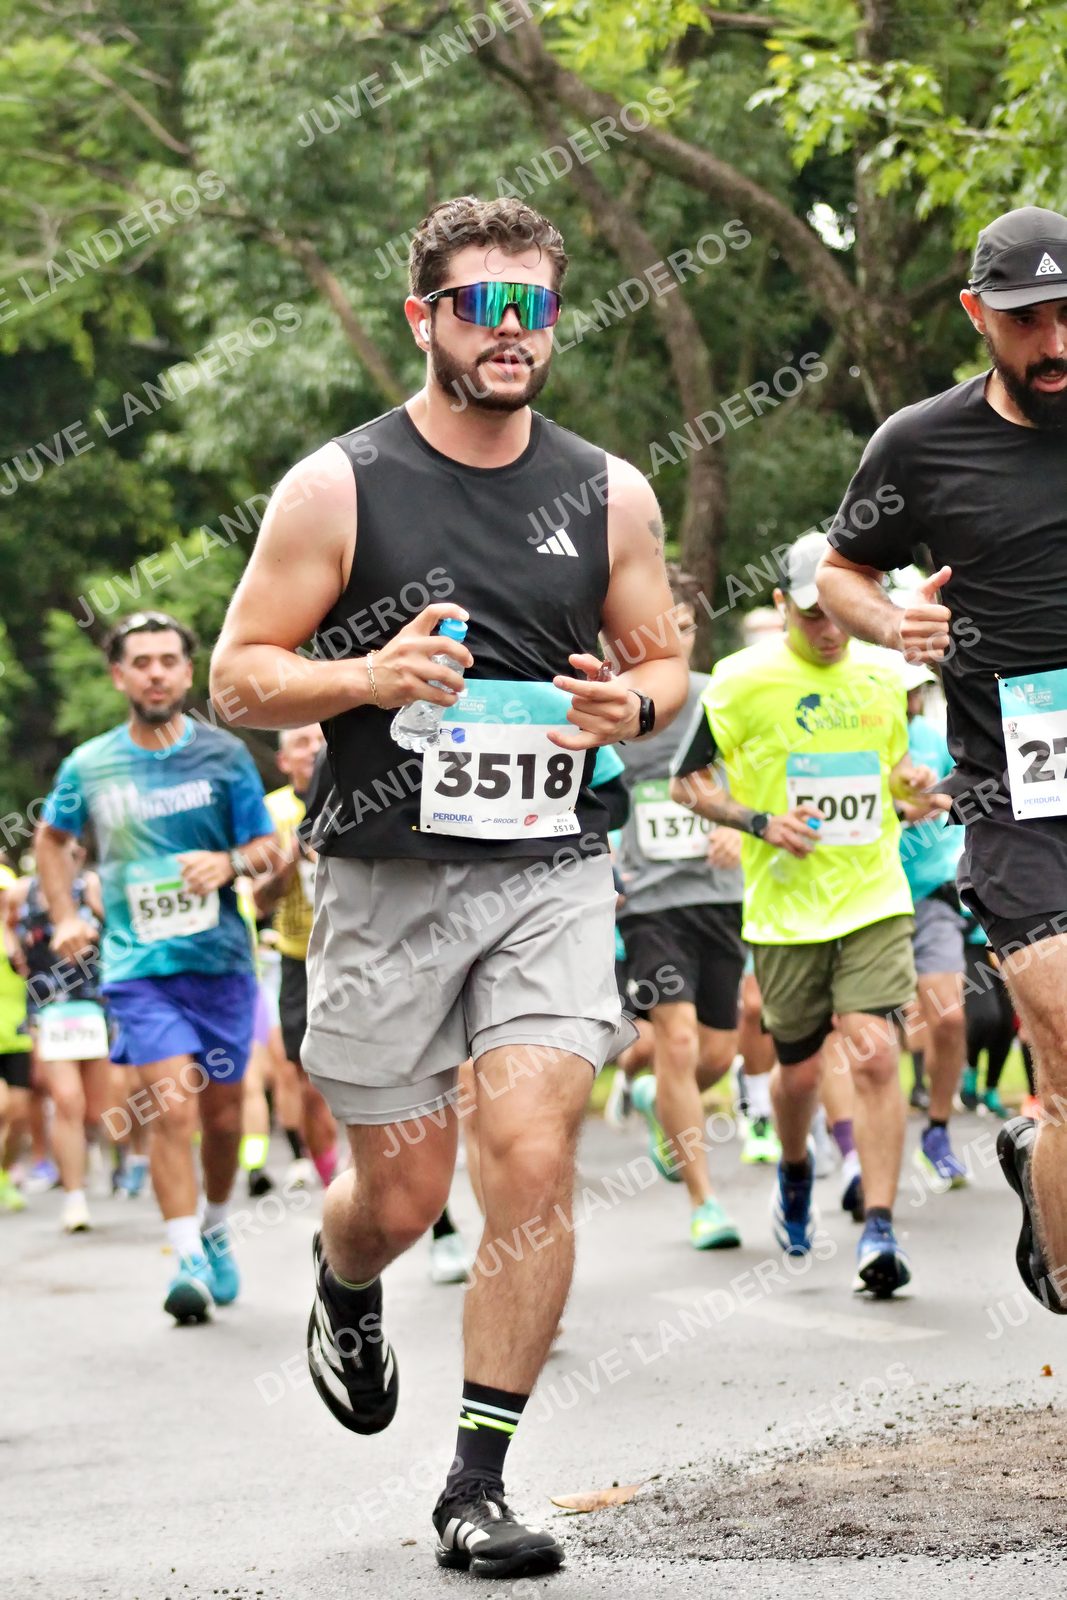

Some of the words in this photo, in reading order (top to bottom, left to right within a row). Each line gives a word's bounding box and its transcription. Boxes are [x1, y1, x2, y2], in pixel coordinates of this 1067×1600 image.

[434, 751, 574, 799] 3518
[1024, 795, 1061, 806] PERDURA
[433, 812, 473, 822] PERDURA
[553, 824, 575, 833] 3518
